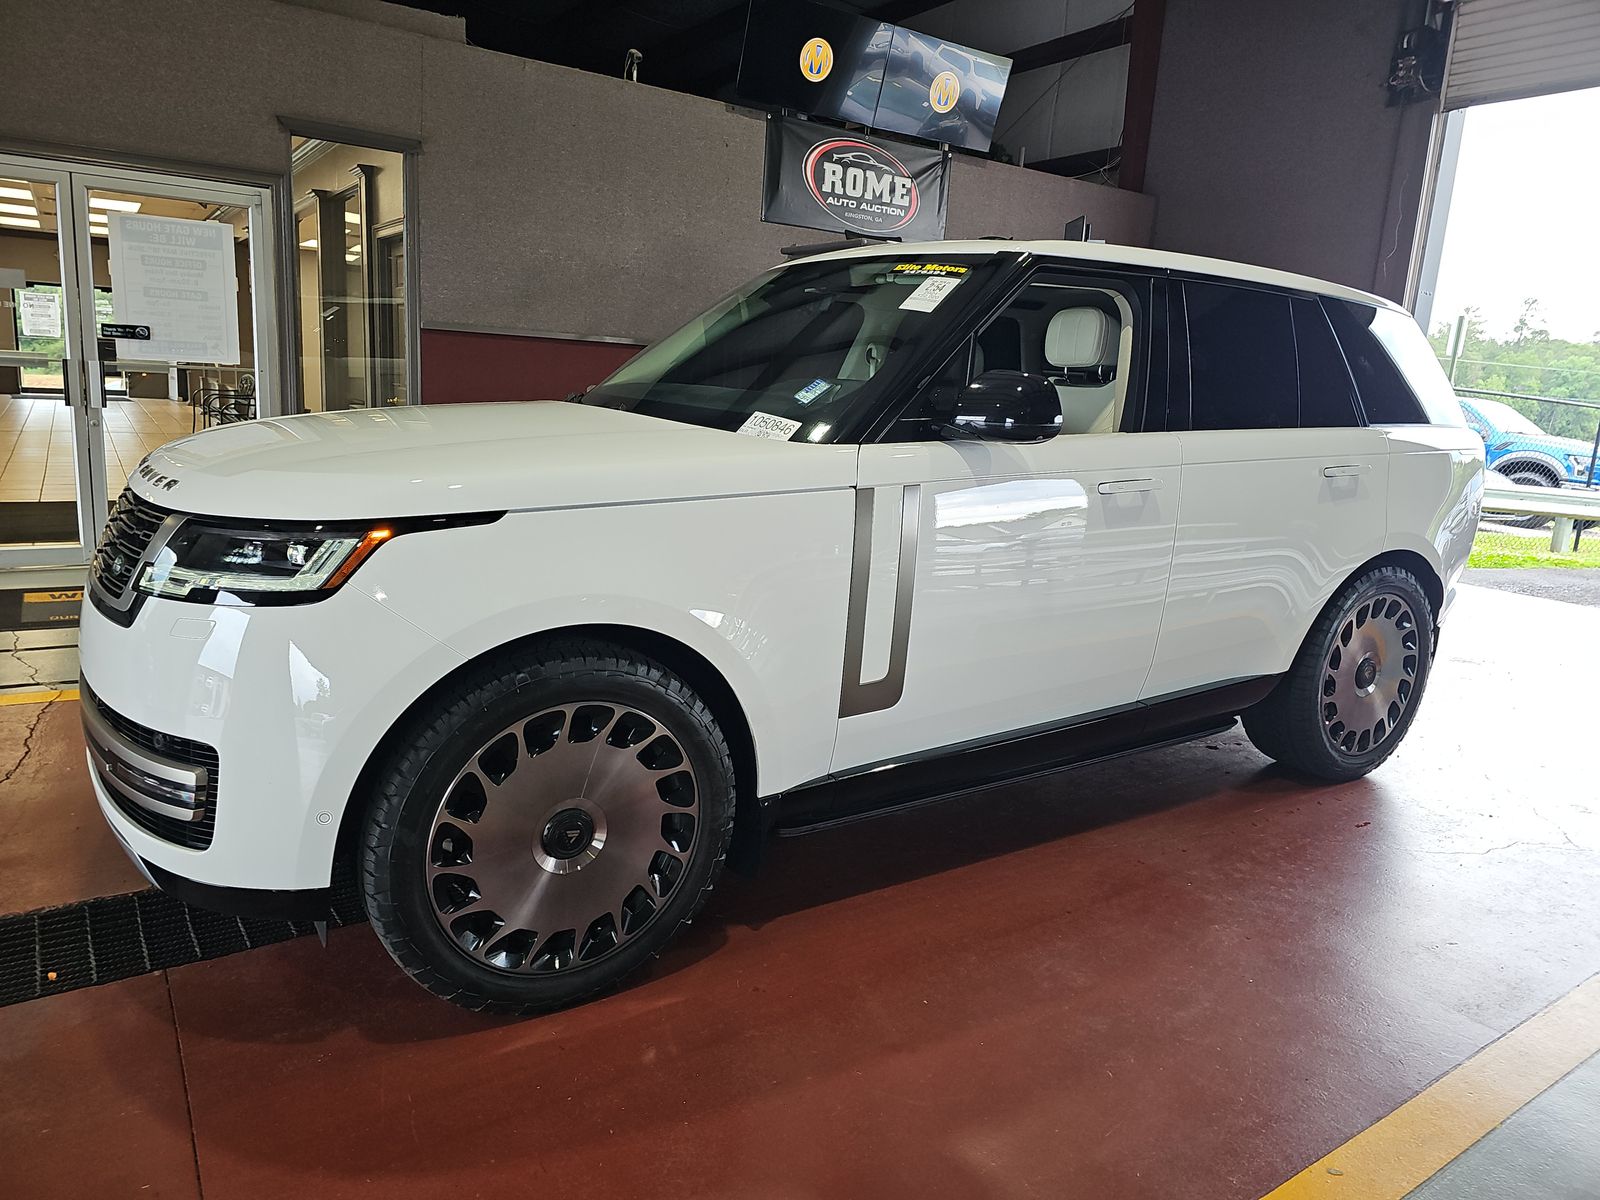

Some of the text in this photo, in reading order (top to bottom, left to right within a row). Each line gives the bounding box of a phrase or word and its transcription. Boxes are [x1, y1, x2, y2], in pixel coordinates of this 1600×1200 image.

[821, 161, 912, 206] ROME
[826, 196, 905, 217] AUTO AUCTION
[844, 211, 874, 222] KINGSTON,
[893, 263, 968, 273] Elite Motors
[749, 415, 795, 435] 1050846
